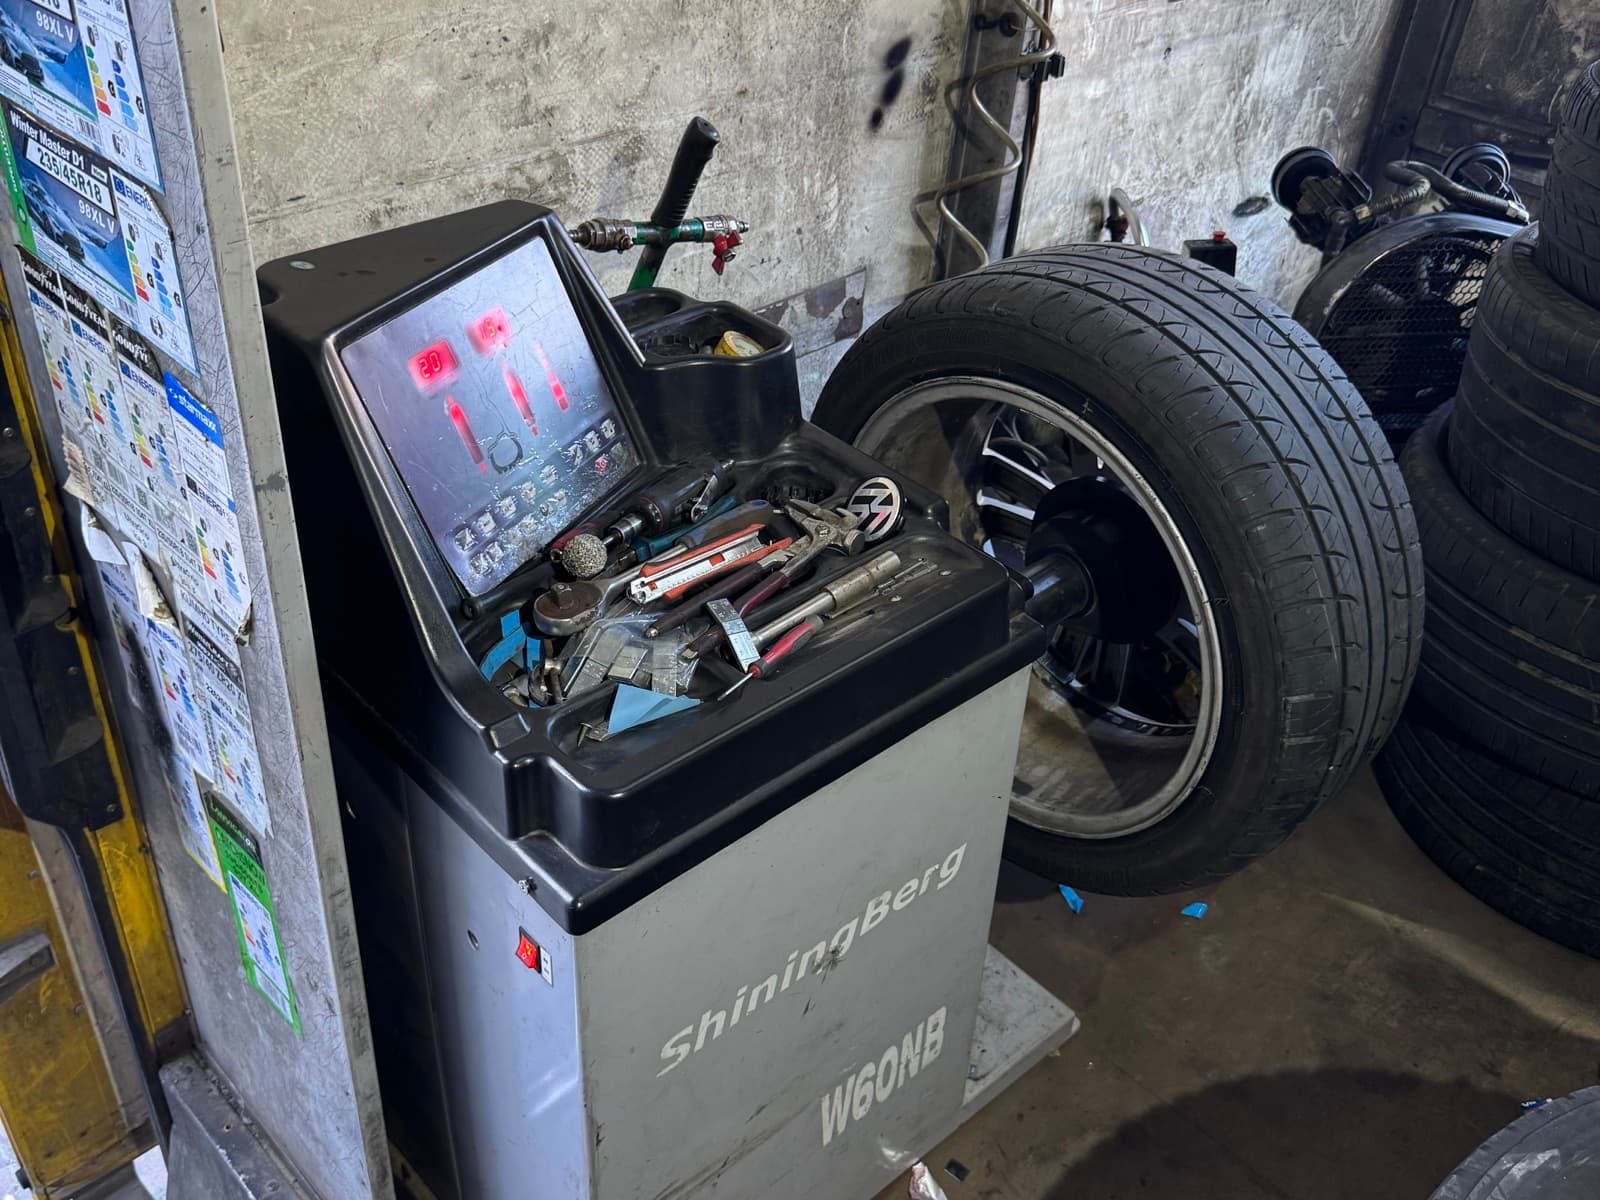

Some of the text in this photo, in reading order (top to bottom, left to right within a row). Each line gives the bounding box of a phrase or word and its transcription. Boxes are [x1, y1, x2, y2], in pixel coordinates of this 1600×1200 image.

[36, 11, 65, 38] 98XL
[65, 25, 74, 43] V
[10, 110, 38, 141] Winter
[39, 129, 71, 163] Master
[72, 147, 85, 170] D1
[38, 147, 102, 203] 235/45R18
[78, 200, 116, 234] 98XL V
[418, 350, 443, 379] 20
[656, 842, 967, 1079] ShiningBerg
